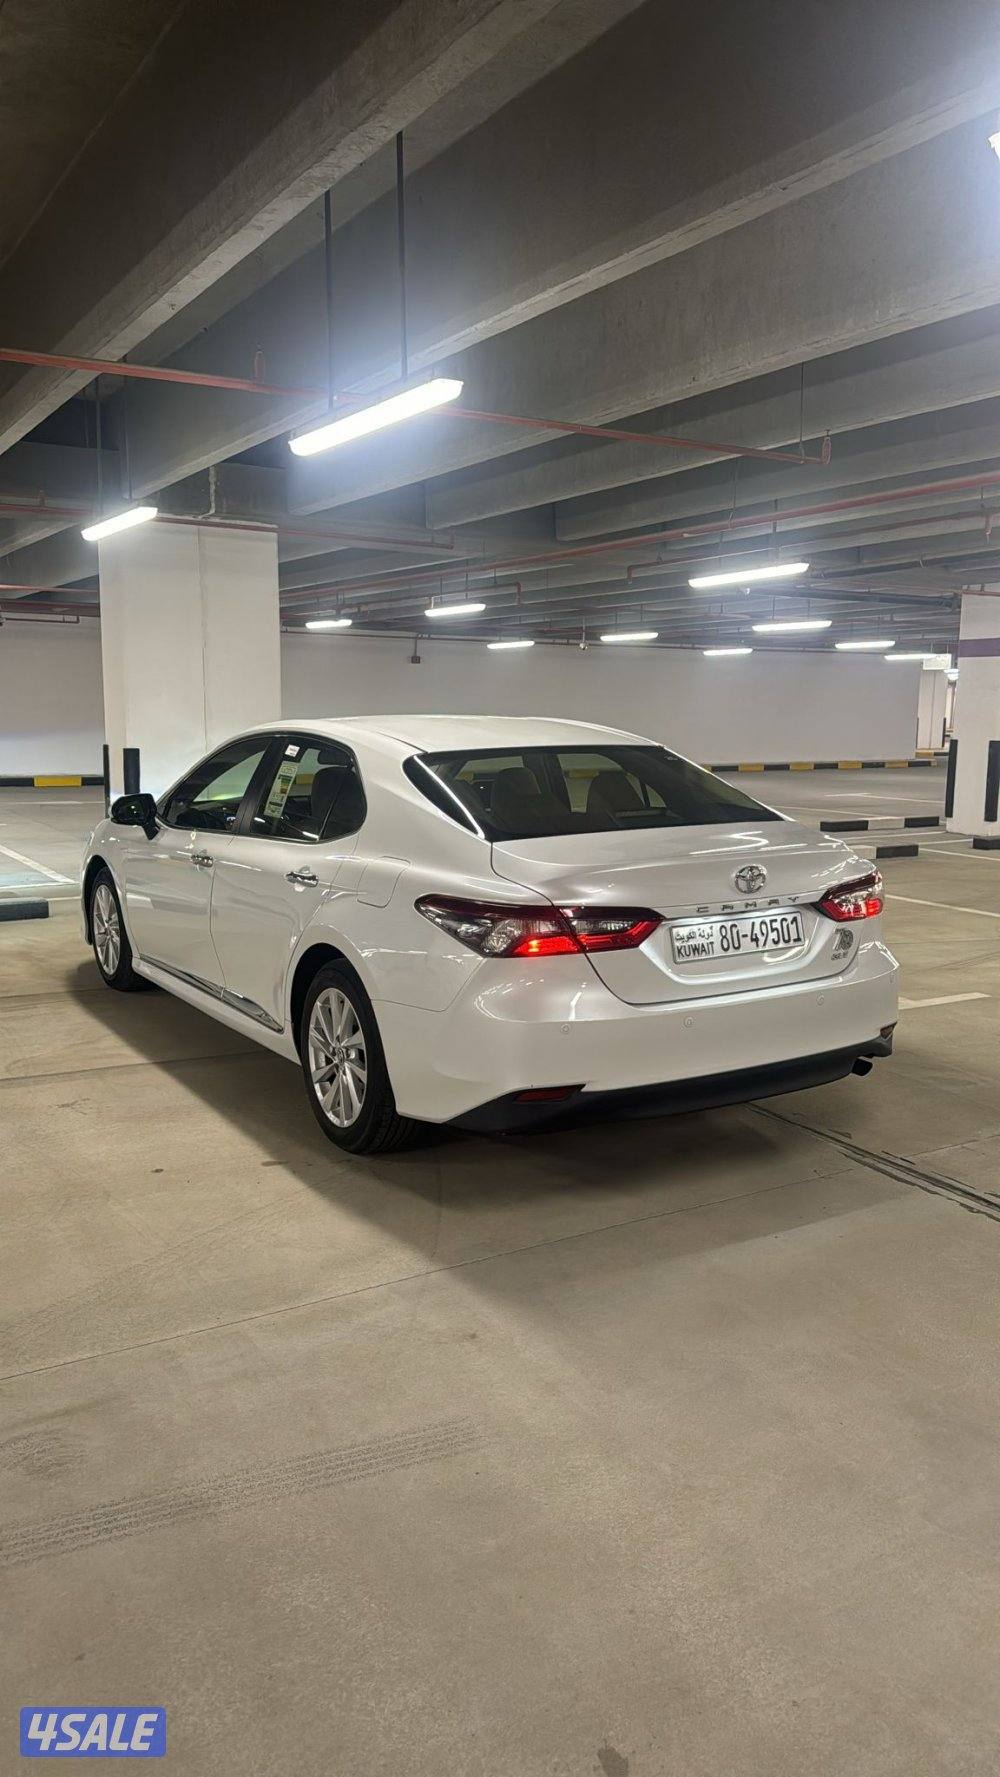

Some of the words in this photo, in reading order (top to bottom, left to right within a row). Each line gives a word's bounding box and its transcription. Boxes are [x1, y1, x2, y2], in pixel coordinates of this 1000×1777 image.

[696, 896, 800, 914] CAMRY
[719, 916, 802, 952] 80-49501
[676, 941, 715, 958] KUWAIT
